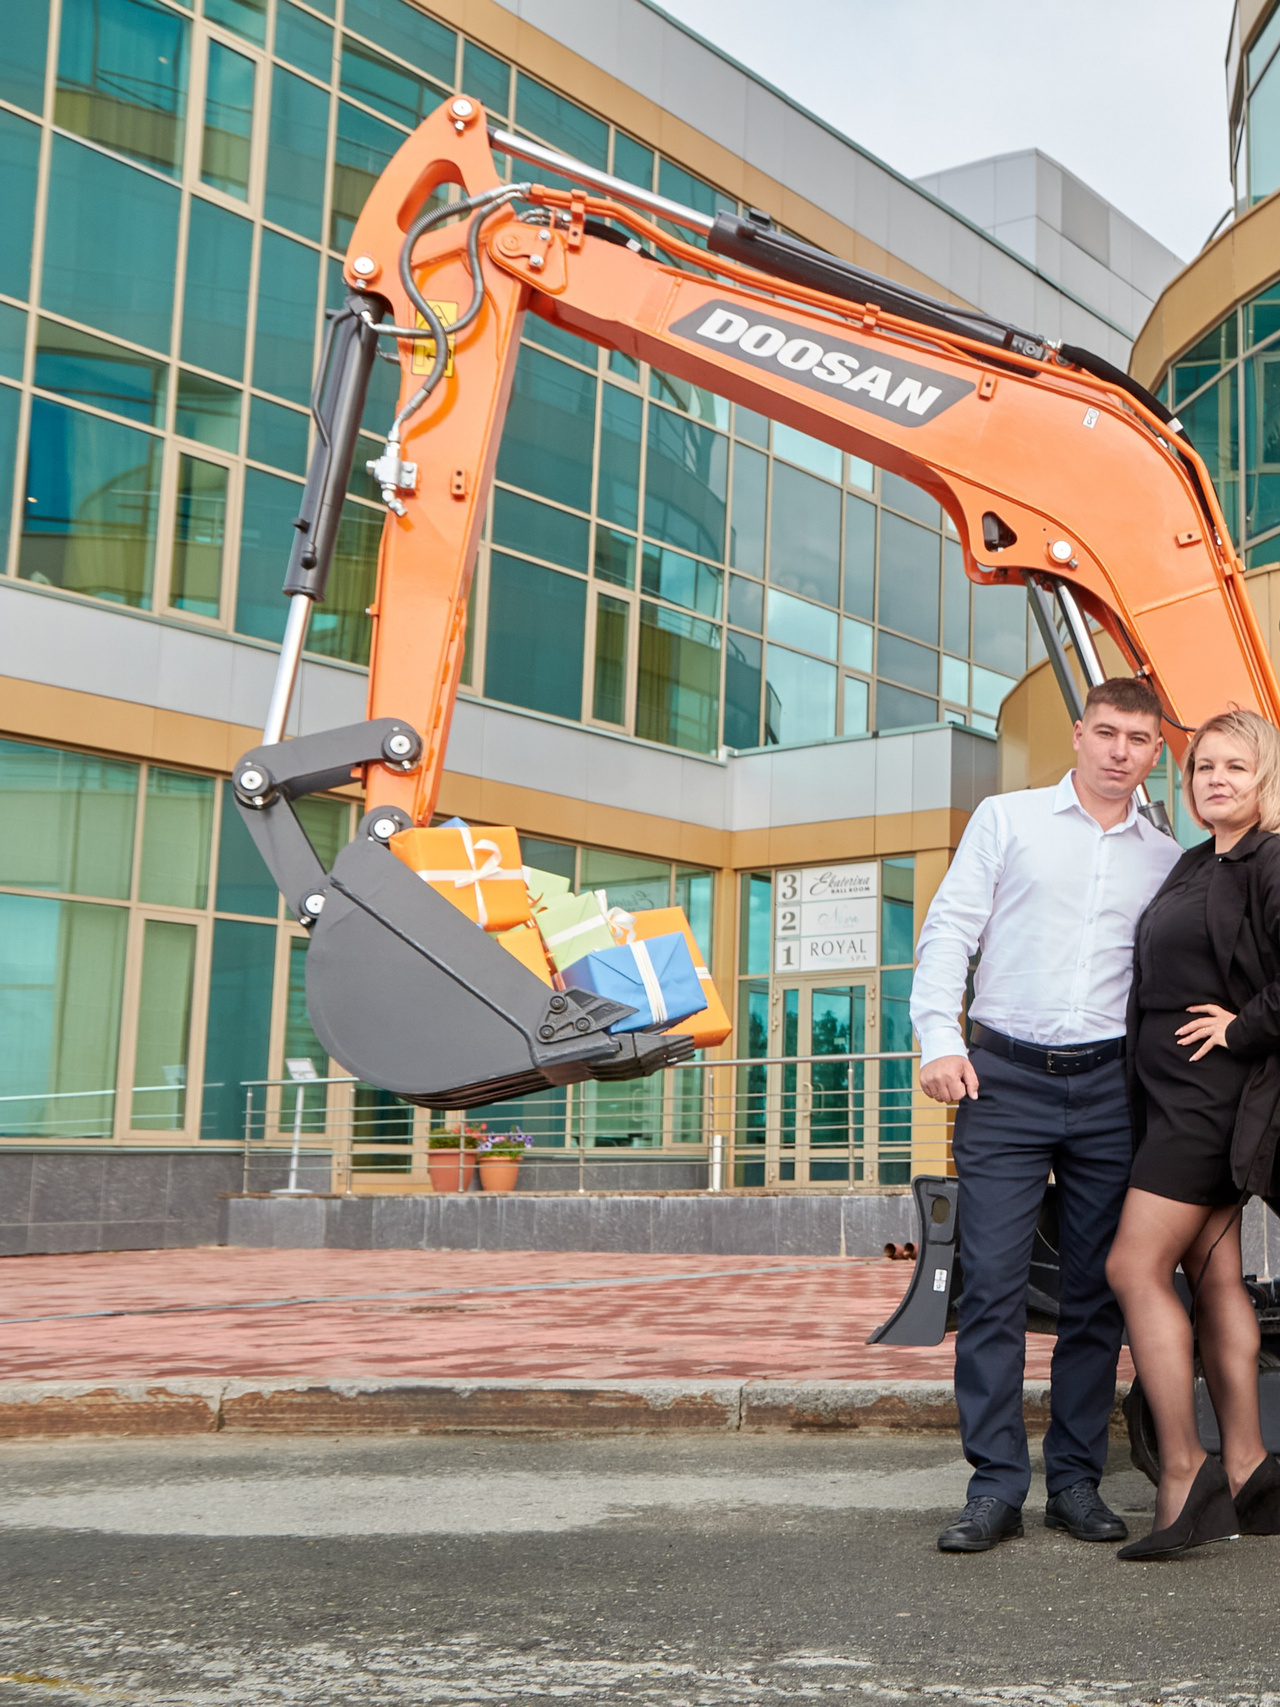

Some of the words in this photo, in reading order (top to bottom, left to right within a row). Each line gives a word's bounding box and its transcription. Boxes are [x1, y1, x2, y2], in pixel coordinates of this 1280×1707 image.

[697, 308, 942, 416] DOOSAN
[782, 874, 797, 900] 3
[810, 872, 870, 896] Ekaterina
[781, 911, 796, 931] 2
[782, 946, 794, 965] 1
[810, 938, 867, 957] ROYAL
